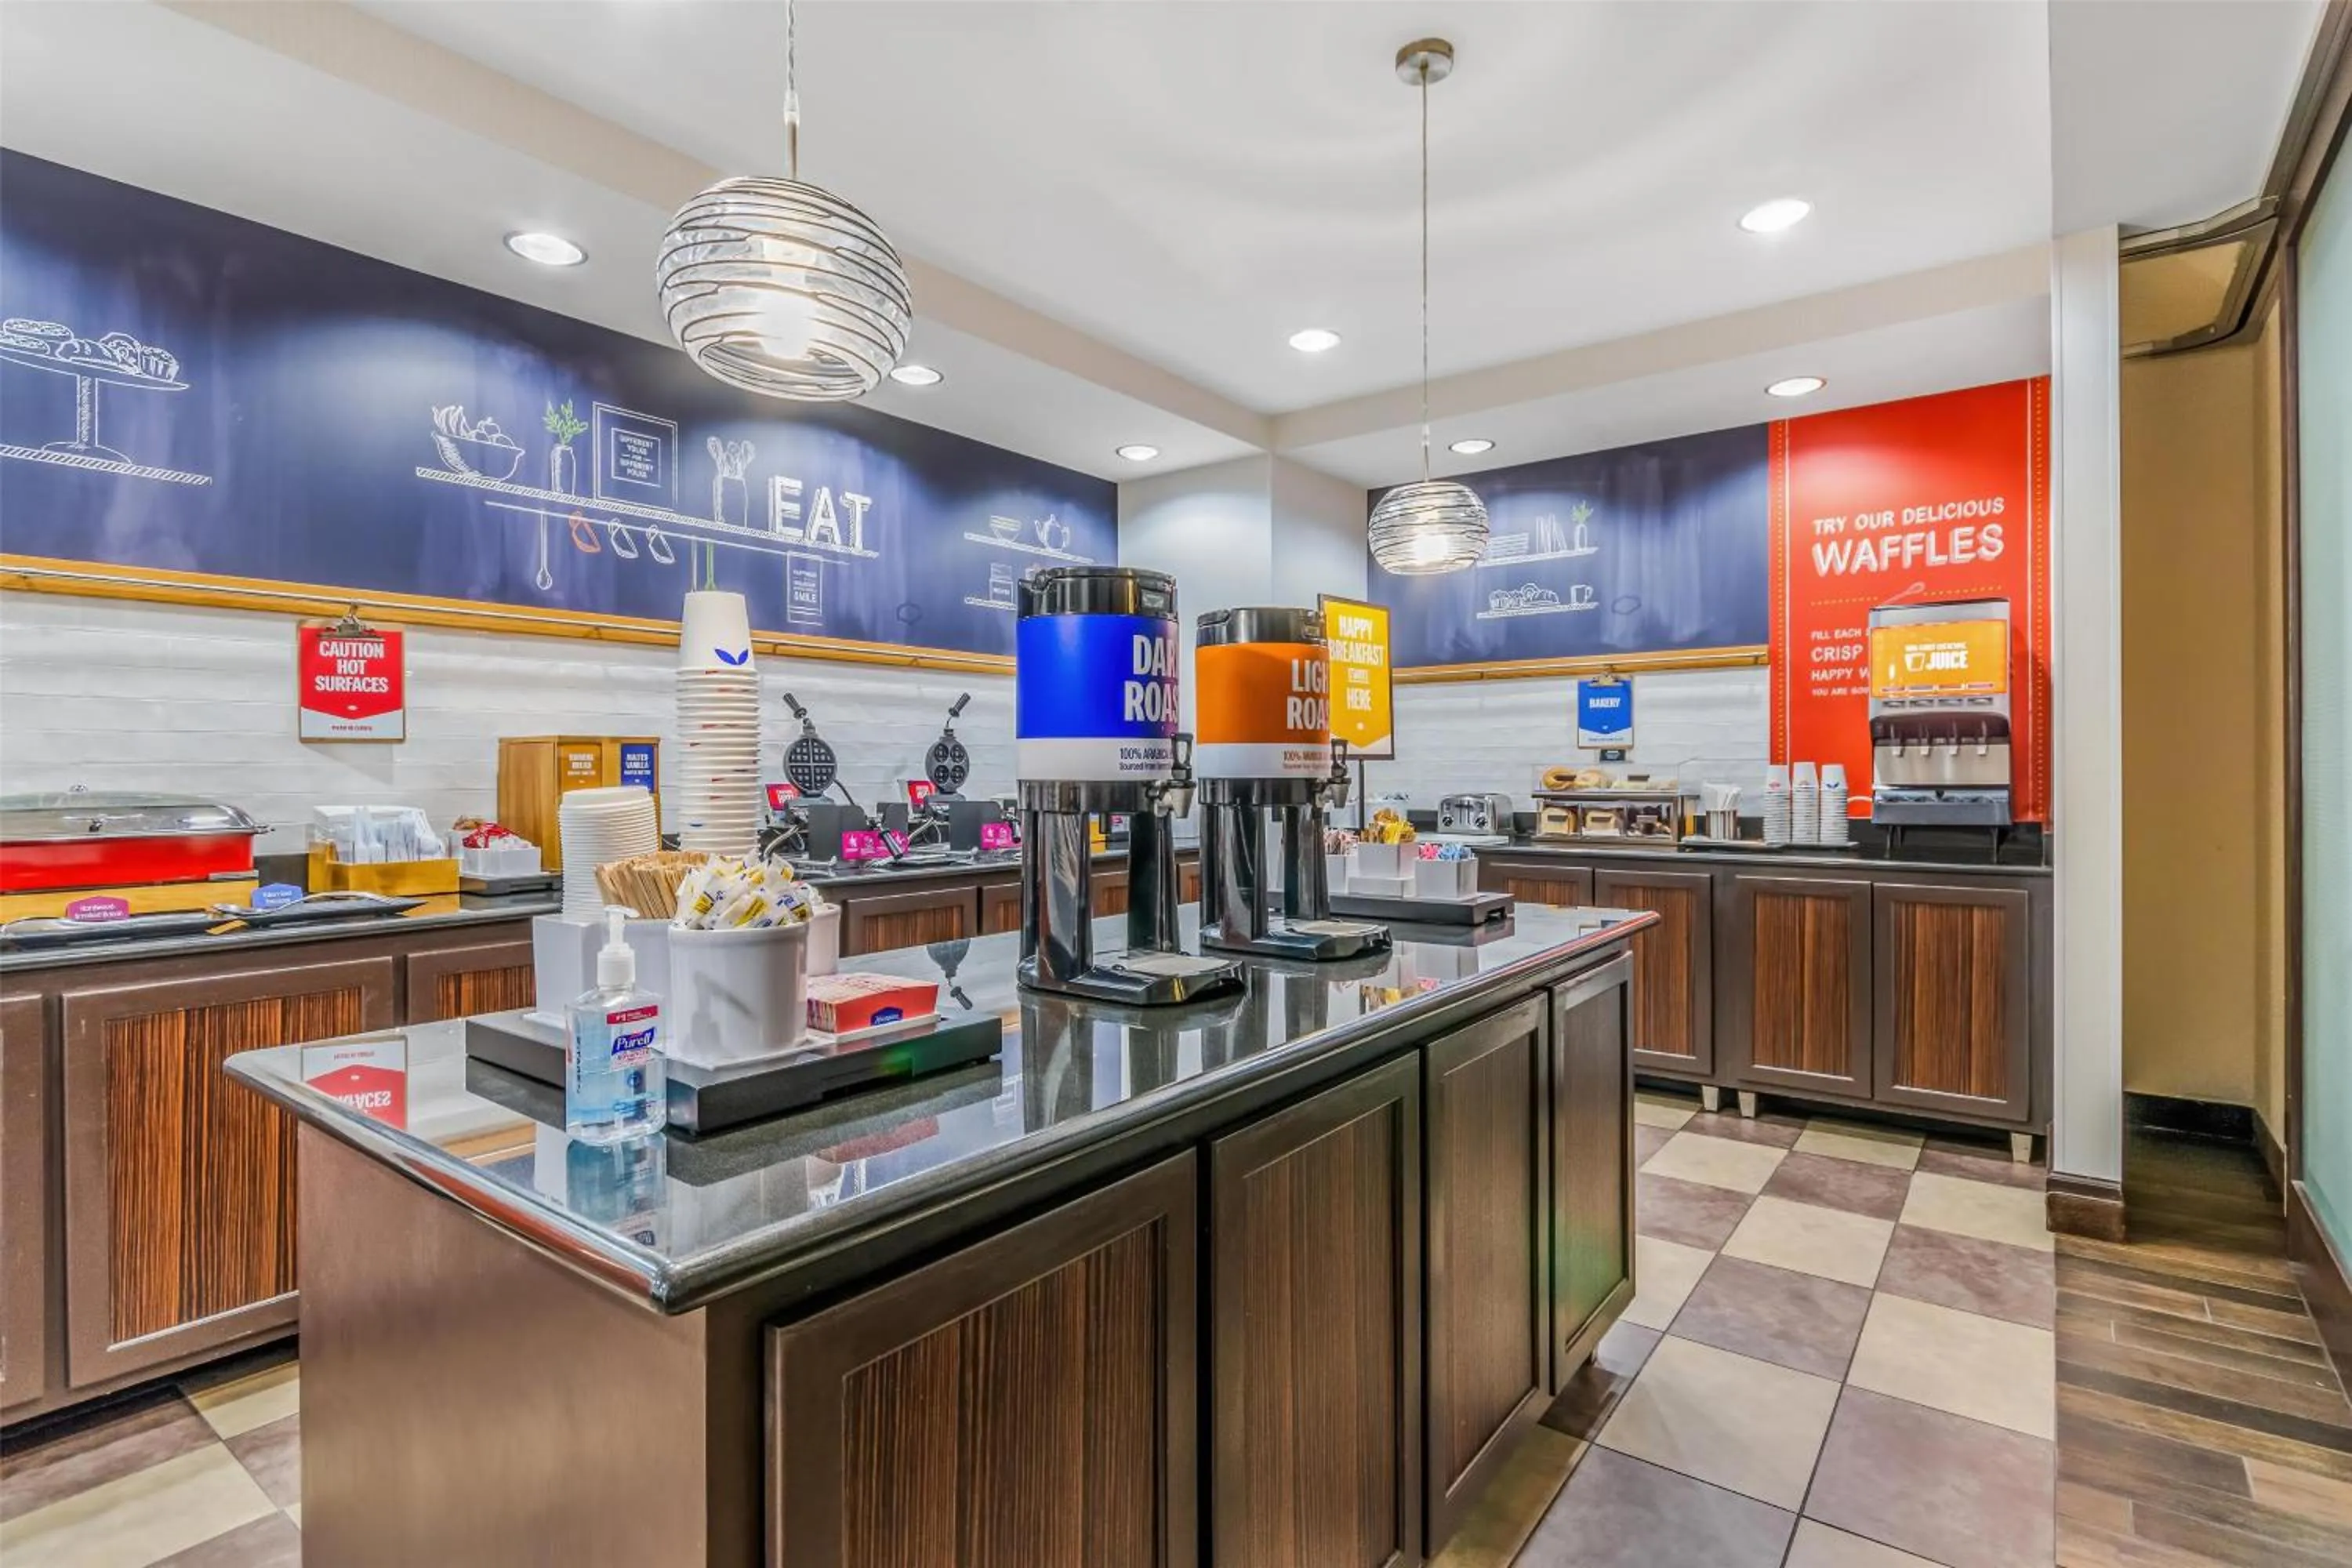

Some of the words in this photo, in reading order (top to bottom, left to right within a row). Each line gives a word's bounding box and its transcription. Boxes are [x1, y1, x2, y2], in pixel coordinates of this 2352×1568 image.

[768, 474, 873, 552] EAT
[1812, 516, 1847, 536] TRY
[1854, 510, 1895, 531] OUR
[1902, 496, 2005, 526] DELICIOUS
[1811, 523, 2005, 577] WAFFLES
[1338, 614, 1374, 641] HAPPY
[319, 641, 385, 659] CAUTION
[1133, 633, 1178, 678] DAR
[1328, 639, 1384, 666] BREAKFAST
[1811, 644, 1864, 662] CRISP
[1925, 650, 1969, 670] JUICE
[336, 659, 368, 675] HOT
[1291, 658, 1330, 695] LIGH
[1811, 667, 1853, 682] HAPPY
[314, 675, 390, 693] SURFACES
[1123, 680, 1179, 724] ROAS
[1287, 695, 1330, 731] ROA
[616, 1033, 652, 1051] Purell
